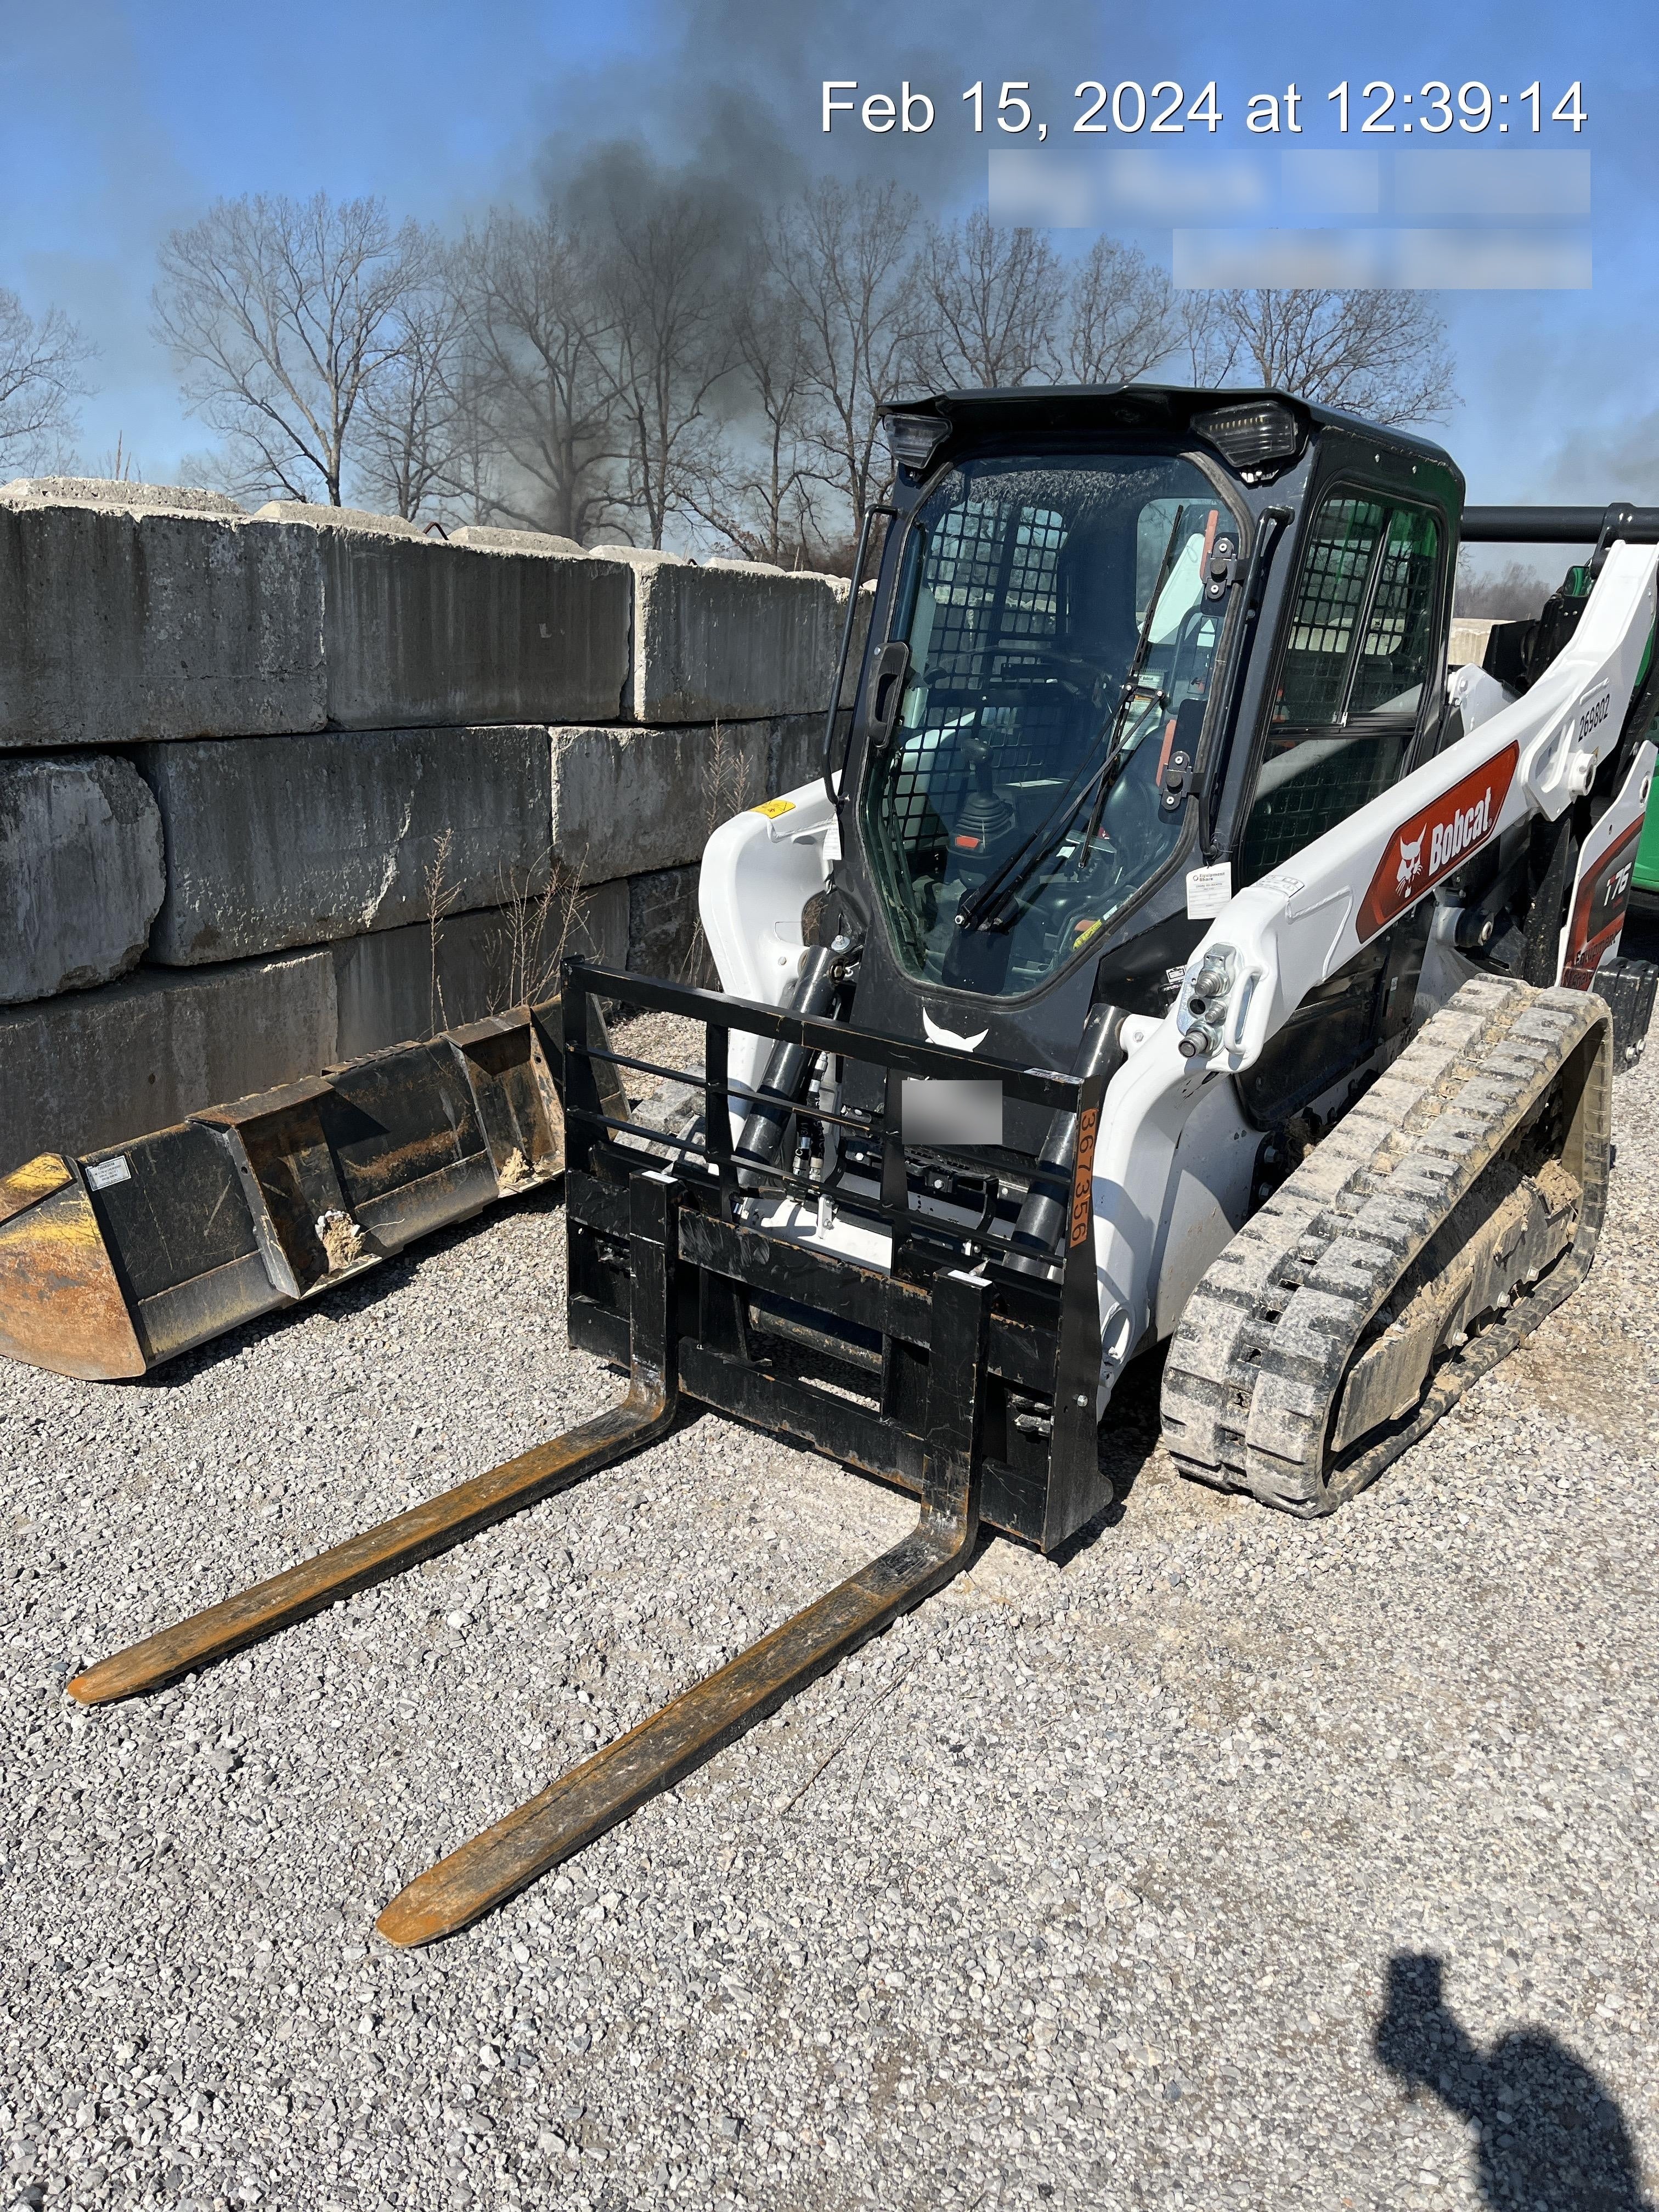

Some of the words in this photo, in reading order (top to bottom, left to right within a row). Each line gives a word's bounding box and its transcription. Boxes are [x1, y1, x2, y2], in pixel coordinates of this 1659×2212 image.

[1578, 693, 1610, 742] 269802
[1428, 786, 1491, 876] Bobcat
[1604, 862, 1632, 907] T76
[1071, 1111, 1096, 1242] 367356
